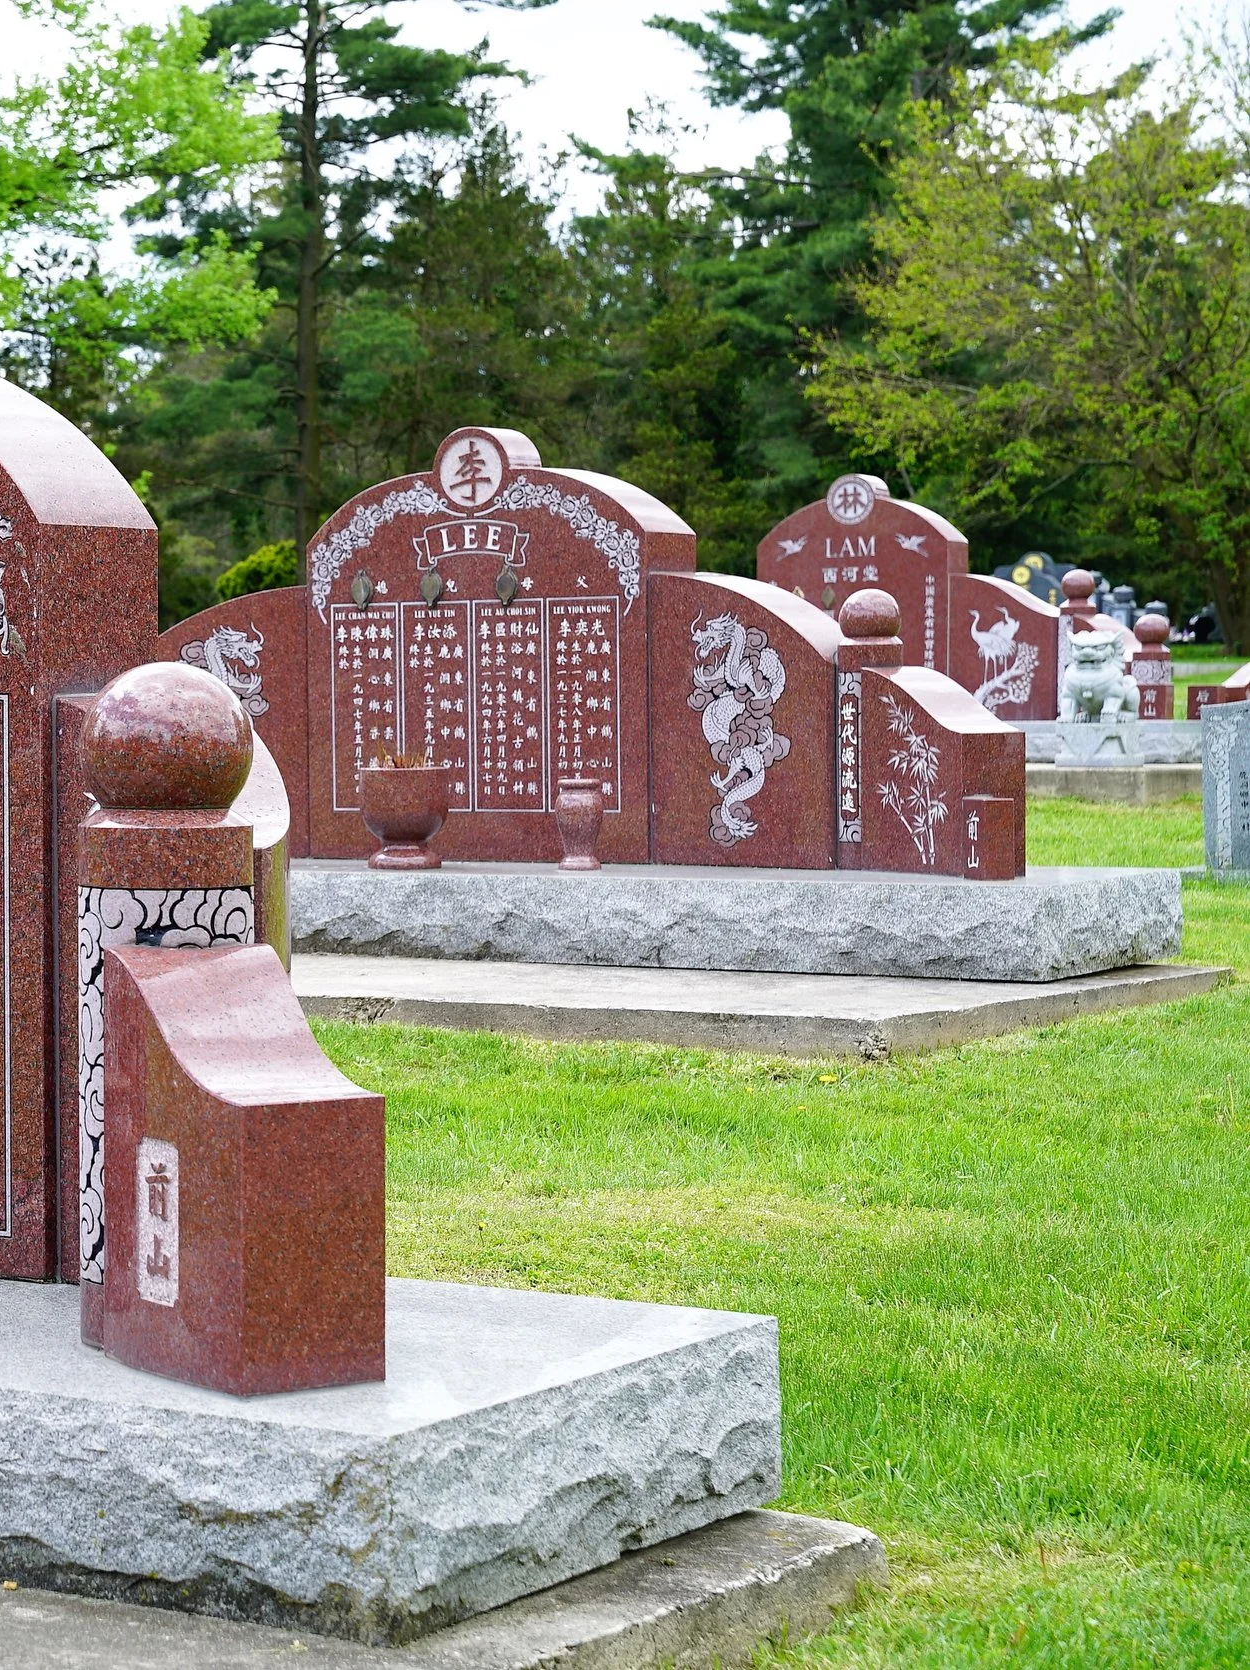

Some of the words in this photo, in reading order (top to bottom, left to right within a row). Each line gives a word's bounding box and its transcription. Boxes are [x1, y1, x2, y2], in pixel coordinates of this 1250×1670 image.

[449, 440, 491, 501] 李
[838, 486, 864, 514] 林
[439, 524, 502, 553] LEE
[825, 535, 876, 559] LAM
[335, 612, 346, 620] LEE
[348, 611, 366, 620] CHAN
[367, 611, 380, 619] WAI
[414, 610, 426, 619] LEE
[480, 608, 492, 617] LEE
[495, 608, 505, 616] AU
[553, 606, 565, 615] LEE
[586, 604, 611, 613] KWONG
[966, 810, 980, 869] 前山
[145, 1162, 172, 1280] 前山
